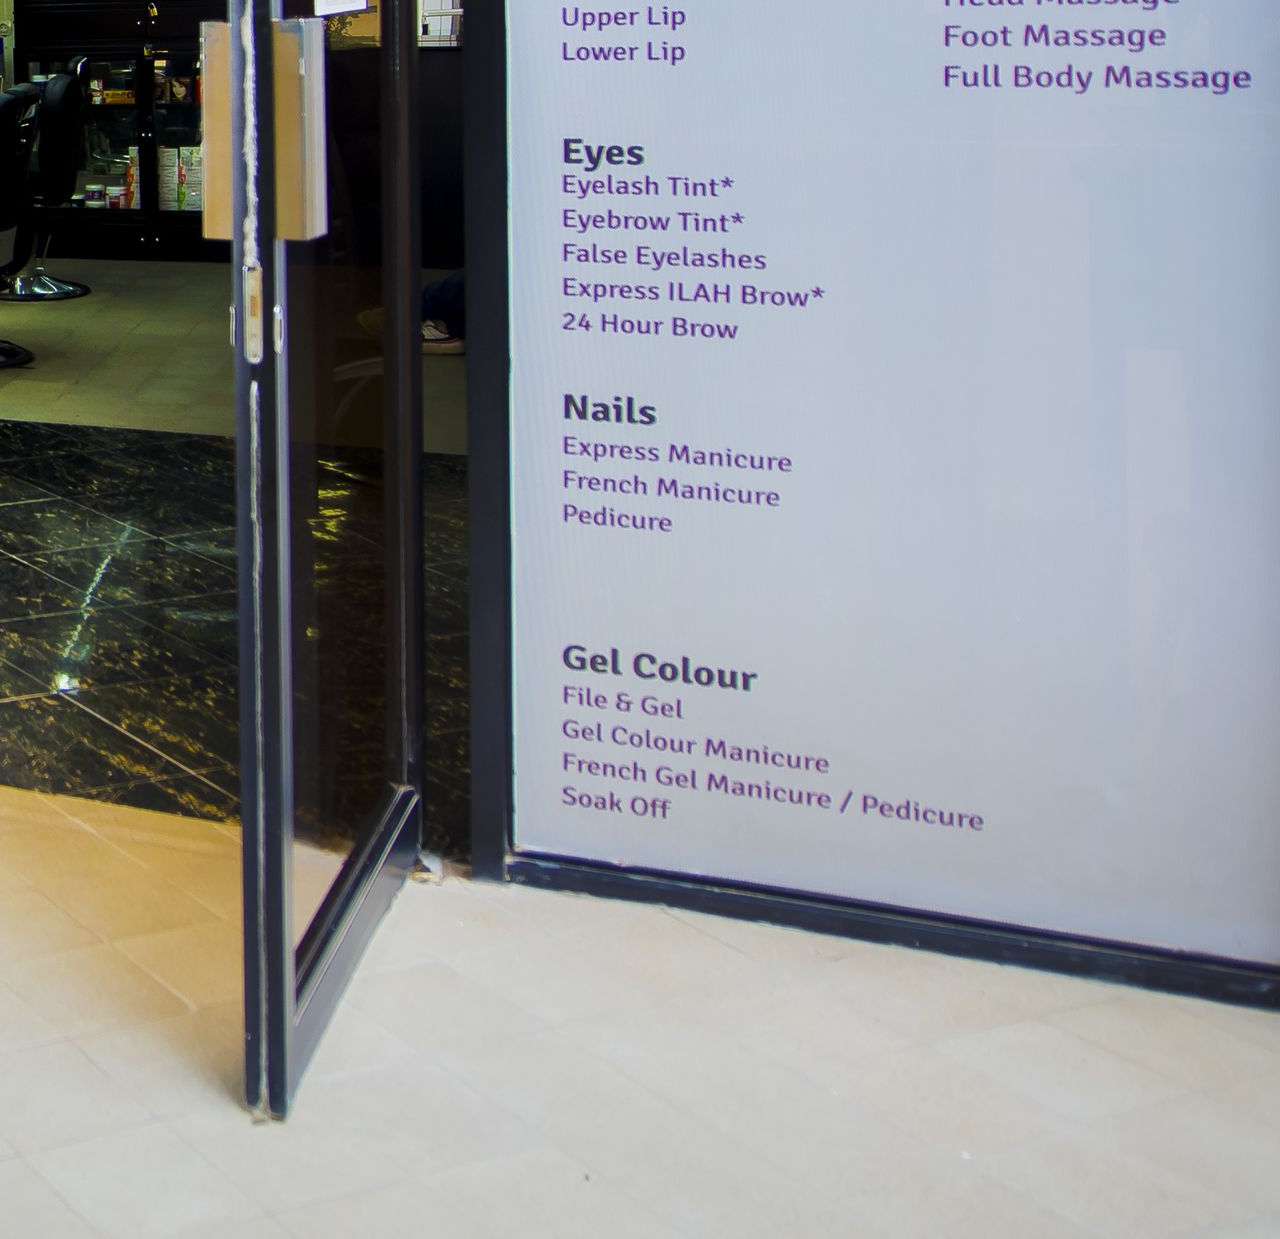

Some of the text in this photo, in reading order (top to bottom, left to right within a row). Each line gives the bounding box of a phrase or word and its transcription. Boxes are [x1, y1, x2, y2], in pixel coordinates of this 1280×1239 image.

[562, 6, 686, 31] Upper Lip
[562, 41, 685, 66] Lower Lip
[944, 24, 1166, 53] Foot Massage
[944, 64, 1251, 95] Full Body Massage
[562, 138, 644, 172] Eyes
[562, 174, 659, 199] Eyelash
[562, 209, 670, 234] Eyebrow
[562, 243, 766, 271] False Eyelashes
[563, 277, 659, 303] Express
[562, 312, 738, 339] 24 Hour Brow
[563, 394, 657, 426] Nails
[563, 436, 792, 472] Express Manicure
[563, 470, 780, 507] French Manicure
[563, 504, 672, 532] Pedicure
[561, 645, 758, 691] Gel Colour
[563, 685, 682, 719] File & Gel
[562, 719, 829, 773] Gel Colour Manicure
[563, 752, 984, 831] French Gel Manicure / Pedicure
[563, 786, 671, 819] Soak Off
